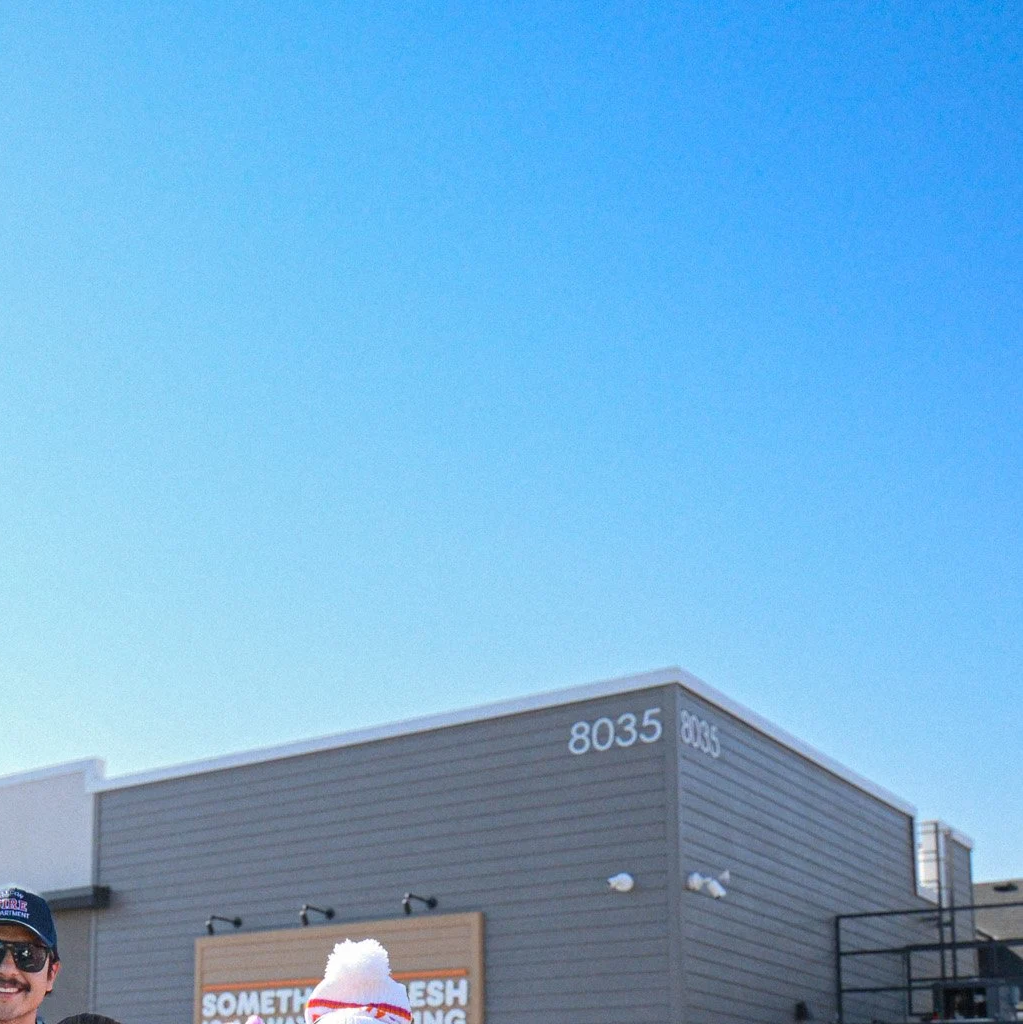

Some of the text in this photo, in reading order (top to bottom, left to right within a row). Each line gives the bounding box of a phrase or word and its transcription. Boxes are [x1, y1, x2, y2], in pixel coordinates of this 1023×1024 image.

[568, 707, 663, 755] 8035
[680, 709, 721, 758] 8035
[201, 978, 468, 1018] SOMETH ESH
